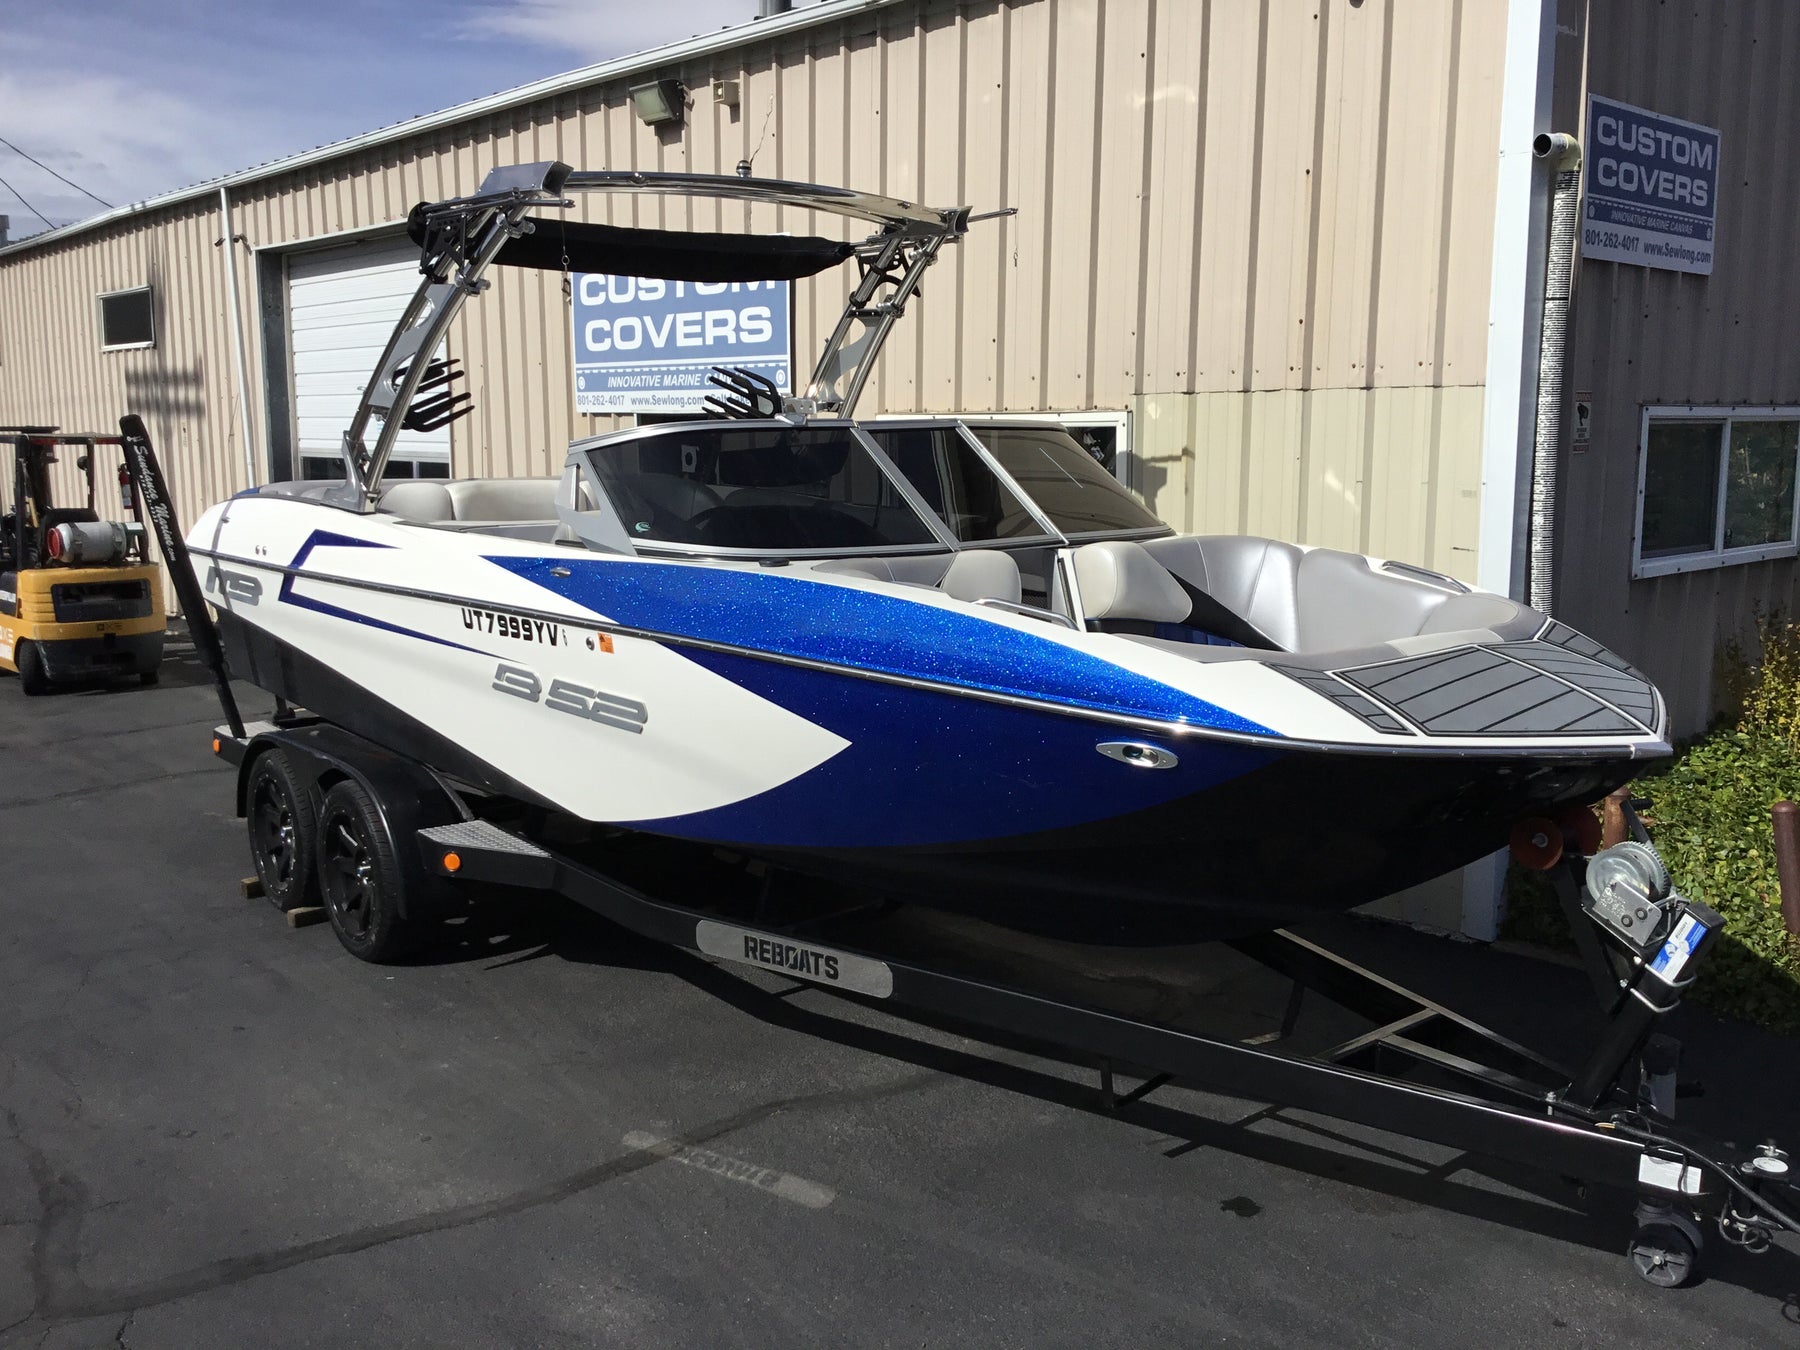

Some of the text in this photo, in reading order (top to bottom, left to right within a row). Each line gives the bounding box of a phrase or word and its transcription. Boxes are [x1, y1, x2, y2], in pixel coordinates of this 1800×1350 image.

[1597, 115, 1713, 171] CUSTOM
[1597, 157, 1709, 207] COVERS
[1611, 210, 1647, 226] INNOVATIVE
[1647, 217, 1671, 231] MARINE
[1585, 229, 1711, 265] 801-262-4017 www.Sewlong.com
[585, 306, 773, 352] COVERS
[608, 371, 743, 388] INNOVATIVE MARINE CANV
[577, 394, 625, 406] 801-262-4017
[631, 393, 705, 409] www.Sewlong.com
[135, 445, 158, 500] Sundance
[462, 608, 558, 646] UT7999YV
[744, 935, 839, 980] REBOATS
